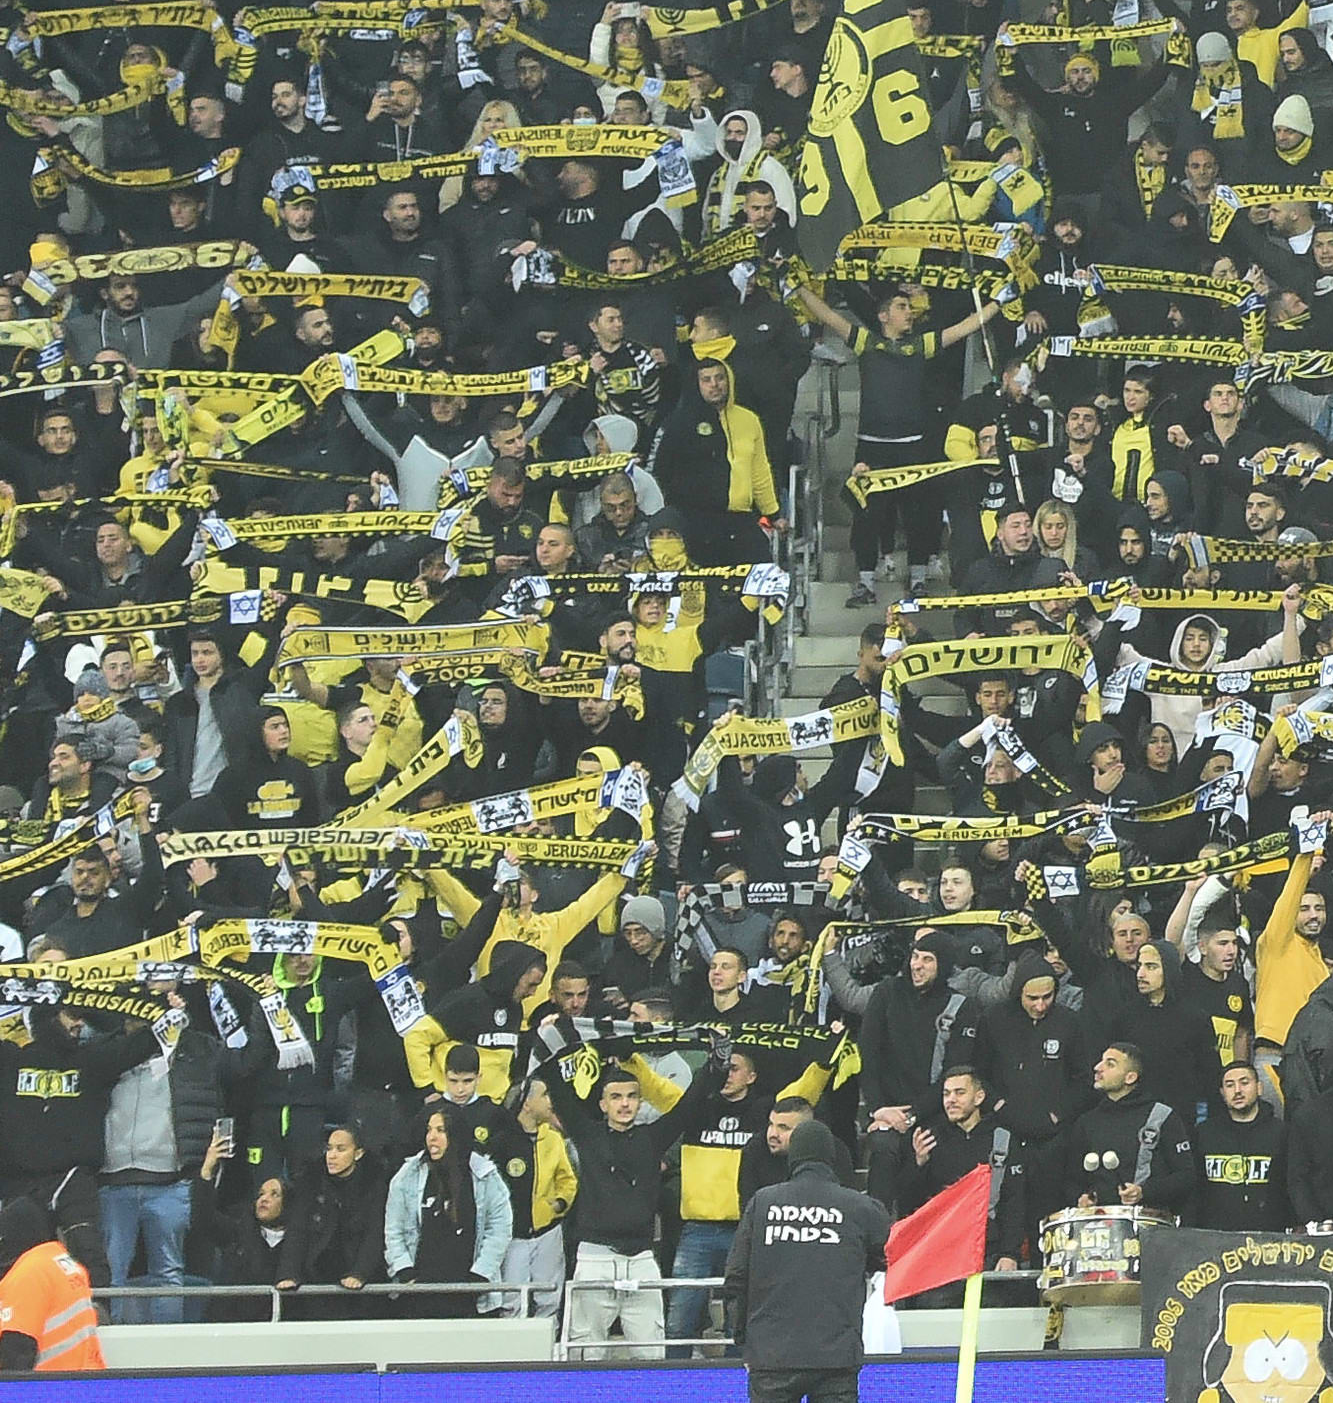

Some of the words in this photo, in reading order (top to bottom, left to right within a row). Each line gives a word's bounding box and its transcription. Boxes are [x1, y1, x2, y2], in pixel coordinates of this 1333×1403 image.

[240, 274, 328, 293] ירושלים
[347, 278, 407, 296] בית"ר
[67, 605, 183, 631] ירושלים
[354, 632, 449, 648] ירושלים
[904, 645, 1052, 673] ירושלים
[427, 666, 486, 684] 2009
[933, 826, 1023, 839] JERUSALEM
[543, 843, 629, 862] JERUSALEM
[1129, 847, 1248, 883] ירושלים
[63, 990, 163, 1020] JERUSALEM
[768, 1205, 843, 1225] התאמה
[766, 1225, 839, 1244] בטחון
[1226, 1242, 1314, 1269] ירושלים
[1183, 1267, 1220, 1300] מאז
[1152, 1300, 1183, 1352] 2005
